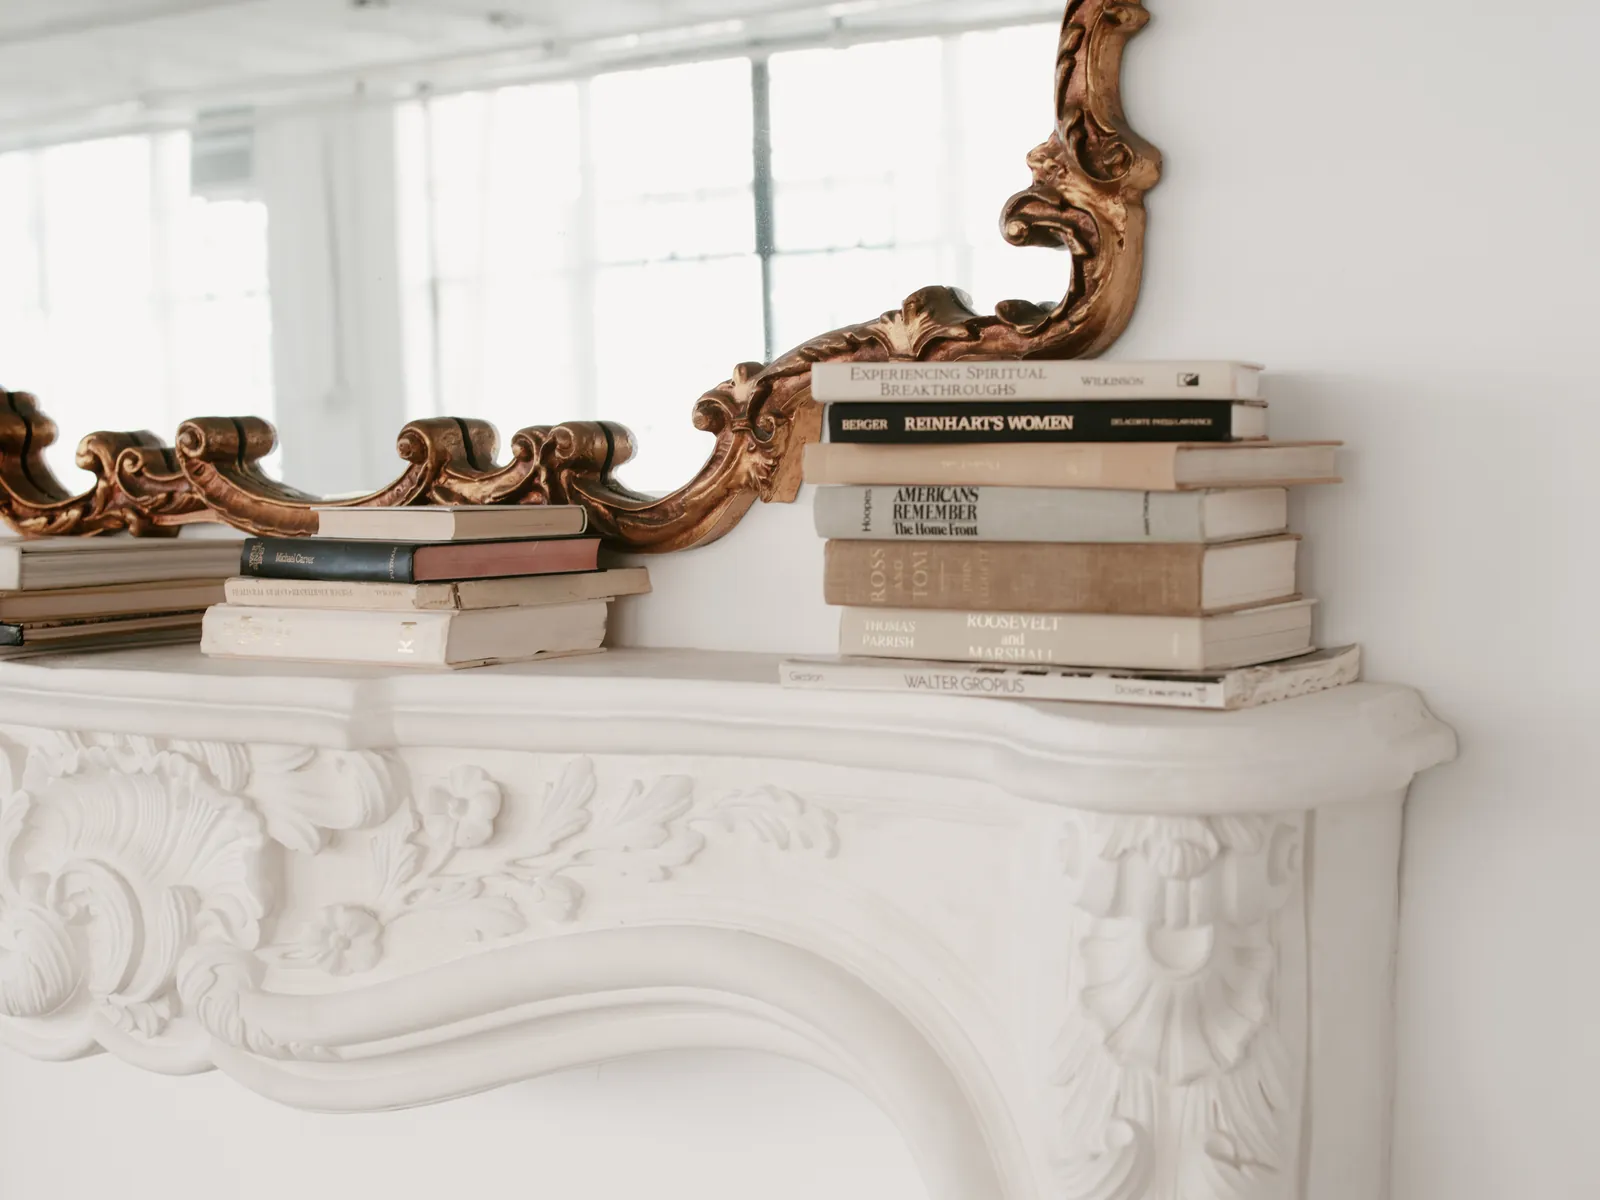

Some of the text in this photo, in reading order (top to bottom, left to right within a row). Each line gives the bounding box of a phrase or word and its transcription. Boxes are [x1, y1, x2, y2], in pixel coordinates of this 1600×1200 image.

[850, 366, 1048, 381] EXPERIENCING SPIRITUAL
[1081, 376, 1145, 386] WILKINSON
[880, 382, 1017, 397] BREAKTHROUGHS
[841, 418, 888, 431] BERGER
[904, 415, 1074, 432] REINHART'S WOMEN
[893, 487, 979, 502] AMERICANS
[861, 488, 872, 533] Hoopes
[893, 504, 977, 521] REMEMBER
[893, 522, 979, 536] The Home Front
[870, 548, 886, 603] ROSS
[912, 549, 928, 600] TOM
[863, 621, 916, 633] THOMAS
[966, 615, 1061, 631] ROOSEVELT
[862, 635, 914, 648] PARRISH
[1001, 633, 1025, 646] and
[905, 674, 1025, 693] WALTER GROPIUS
